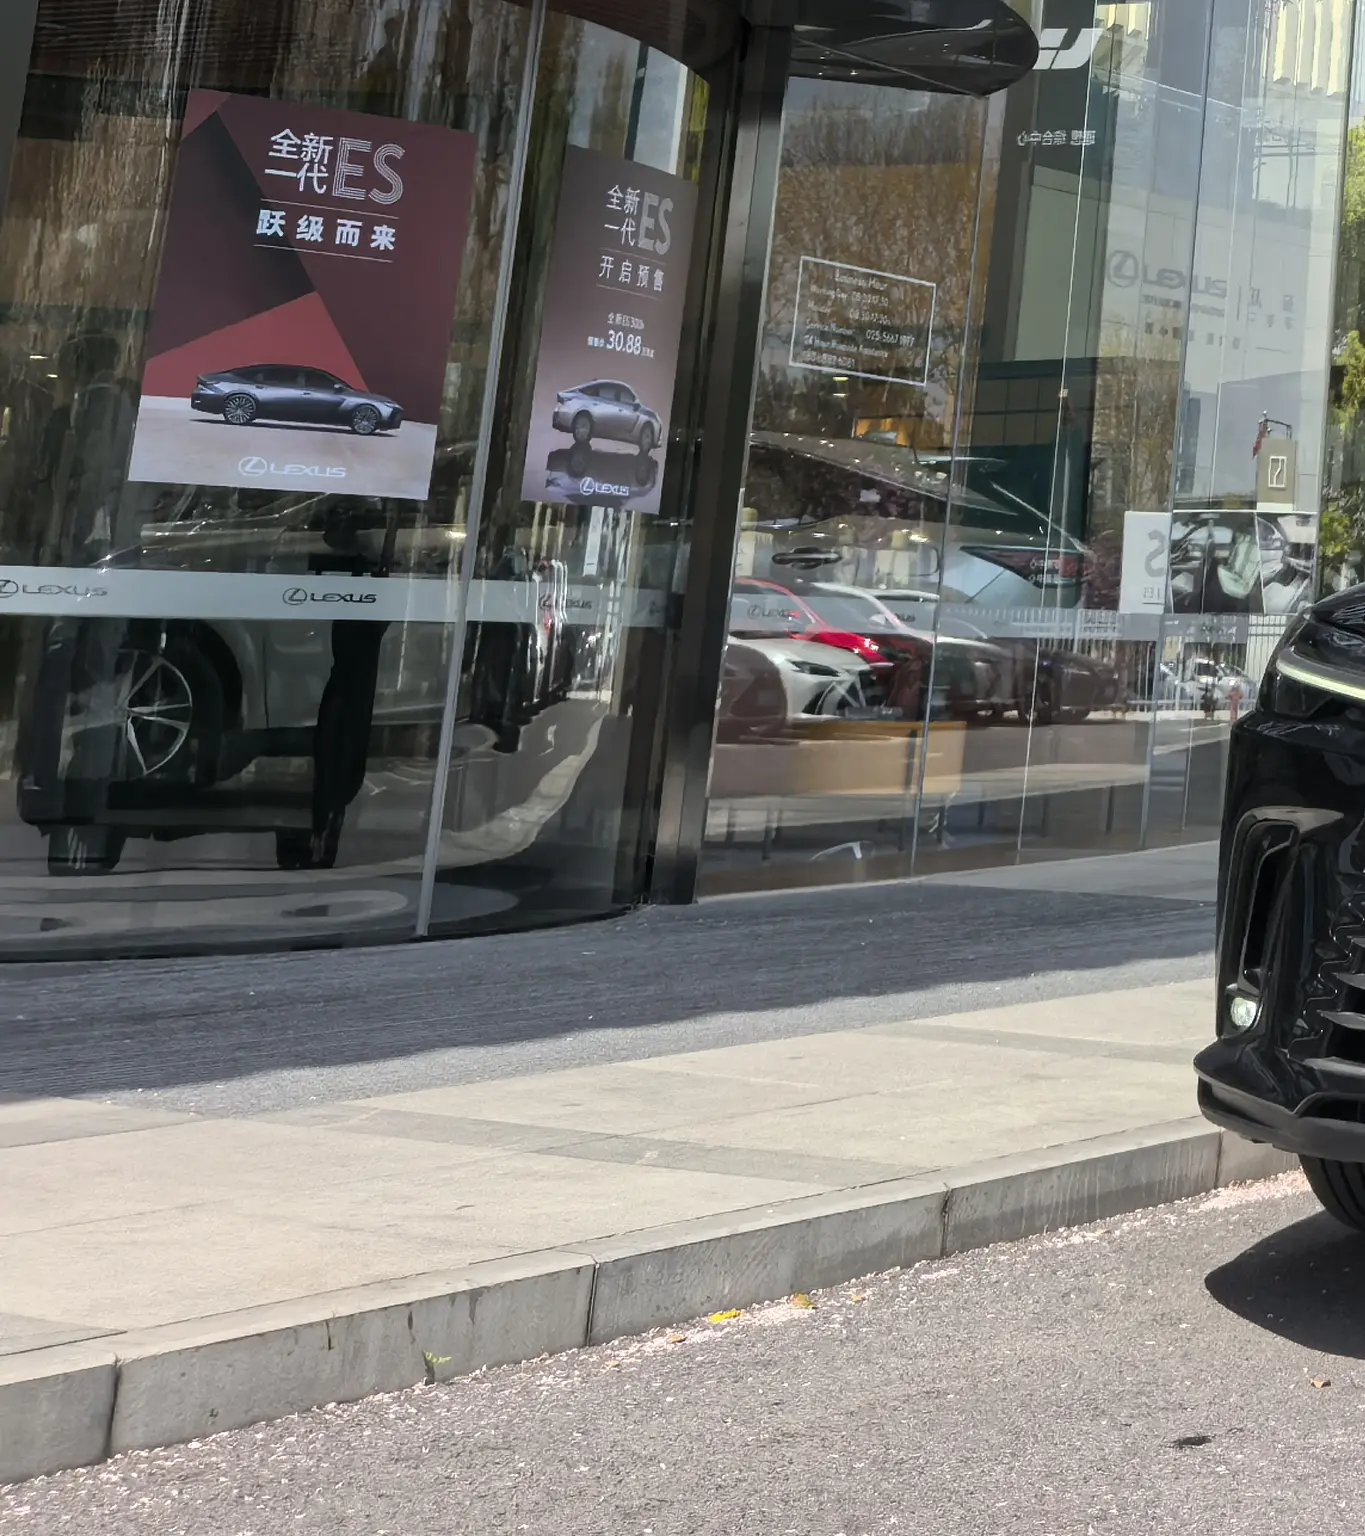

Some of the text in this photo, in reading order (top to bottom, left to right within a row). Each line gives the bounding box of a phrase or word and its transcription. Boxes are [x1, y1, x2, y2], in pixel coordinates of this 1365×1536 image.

[268, 128, 334, 164] 全新
[264, 163, 330, 194] 一代
[332, 136, 406, 205] ES
[604, 184, 641, 216] 全新
[256, 209, 396, 251] 跃级而来
[604, 217, 637, 246] 一代
[637, 191, 674, 255] ES
[598, 255, 664, 292] 开启预售
[606, 329, 642, 355] 30.88
[270, 463, 347, 478] LEXUS
[595, 482, 630, 496] LEXUS
[22, 584, 108, 597] LEXUS
[310, 592, 377, 604] LEXUS
